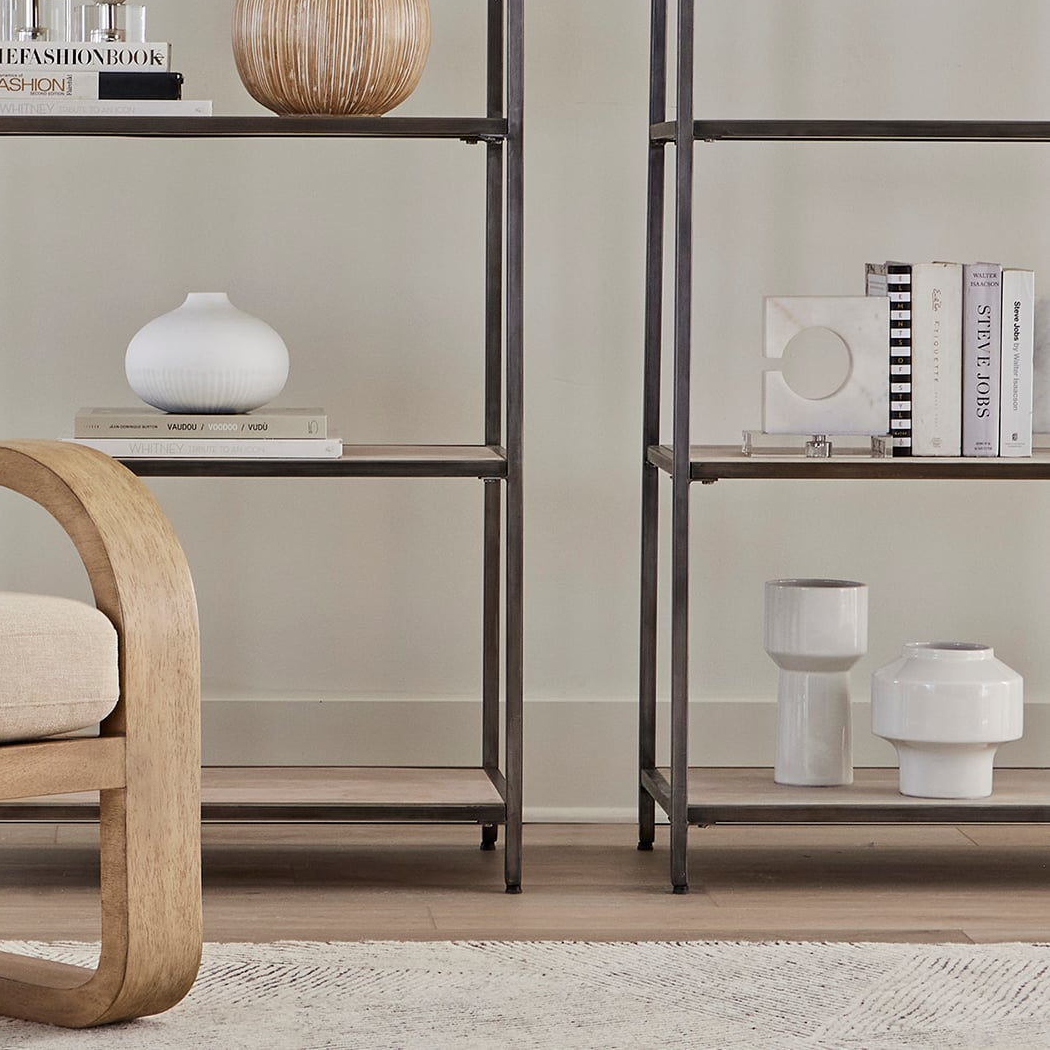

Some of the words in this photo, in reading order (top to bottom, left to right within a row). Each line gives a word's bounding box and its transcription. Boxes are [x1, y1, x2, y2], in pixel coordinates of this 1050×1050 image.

[0, 103, 55, 114] WHITNEY
[1013, 301, 1021, 322] Steve
[977, 305, 991, 367] STEVE
[1013, 323, 1021, 341] Jobs
[1012, 343, 1020, 353] by
[1013, 353, 1021, 376] Walter
[976, 373, 991, 418] JOBS
[1012, 378, 1020, 411] Isaacson
[130, 443, 184, 455] WHITNEY
